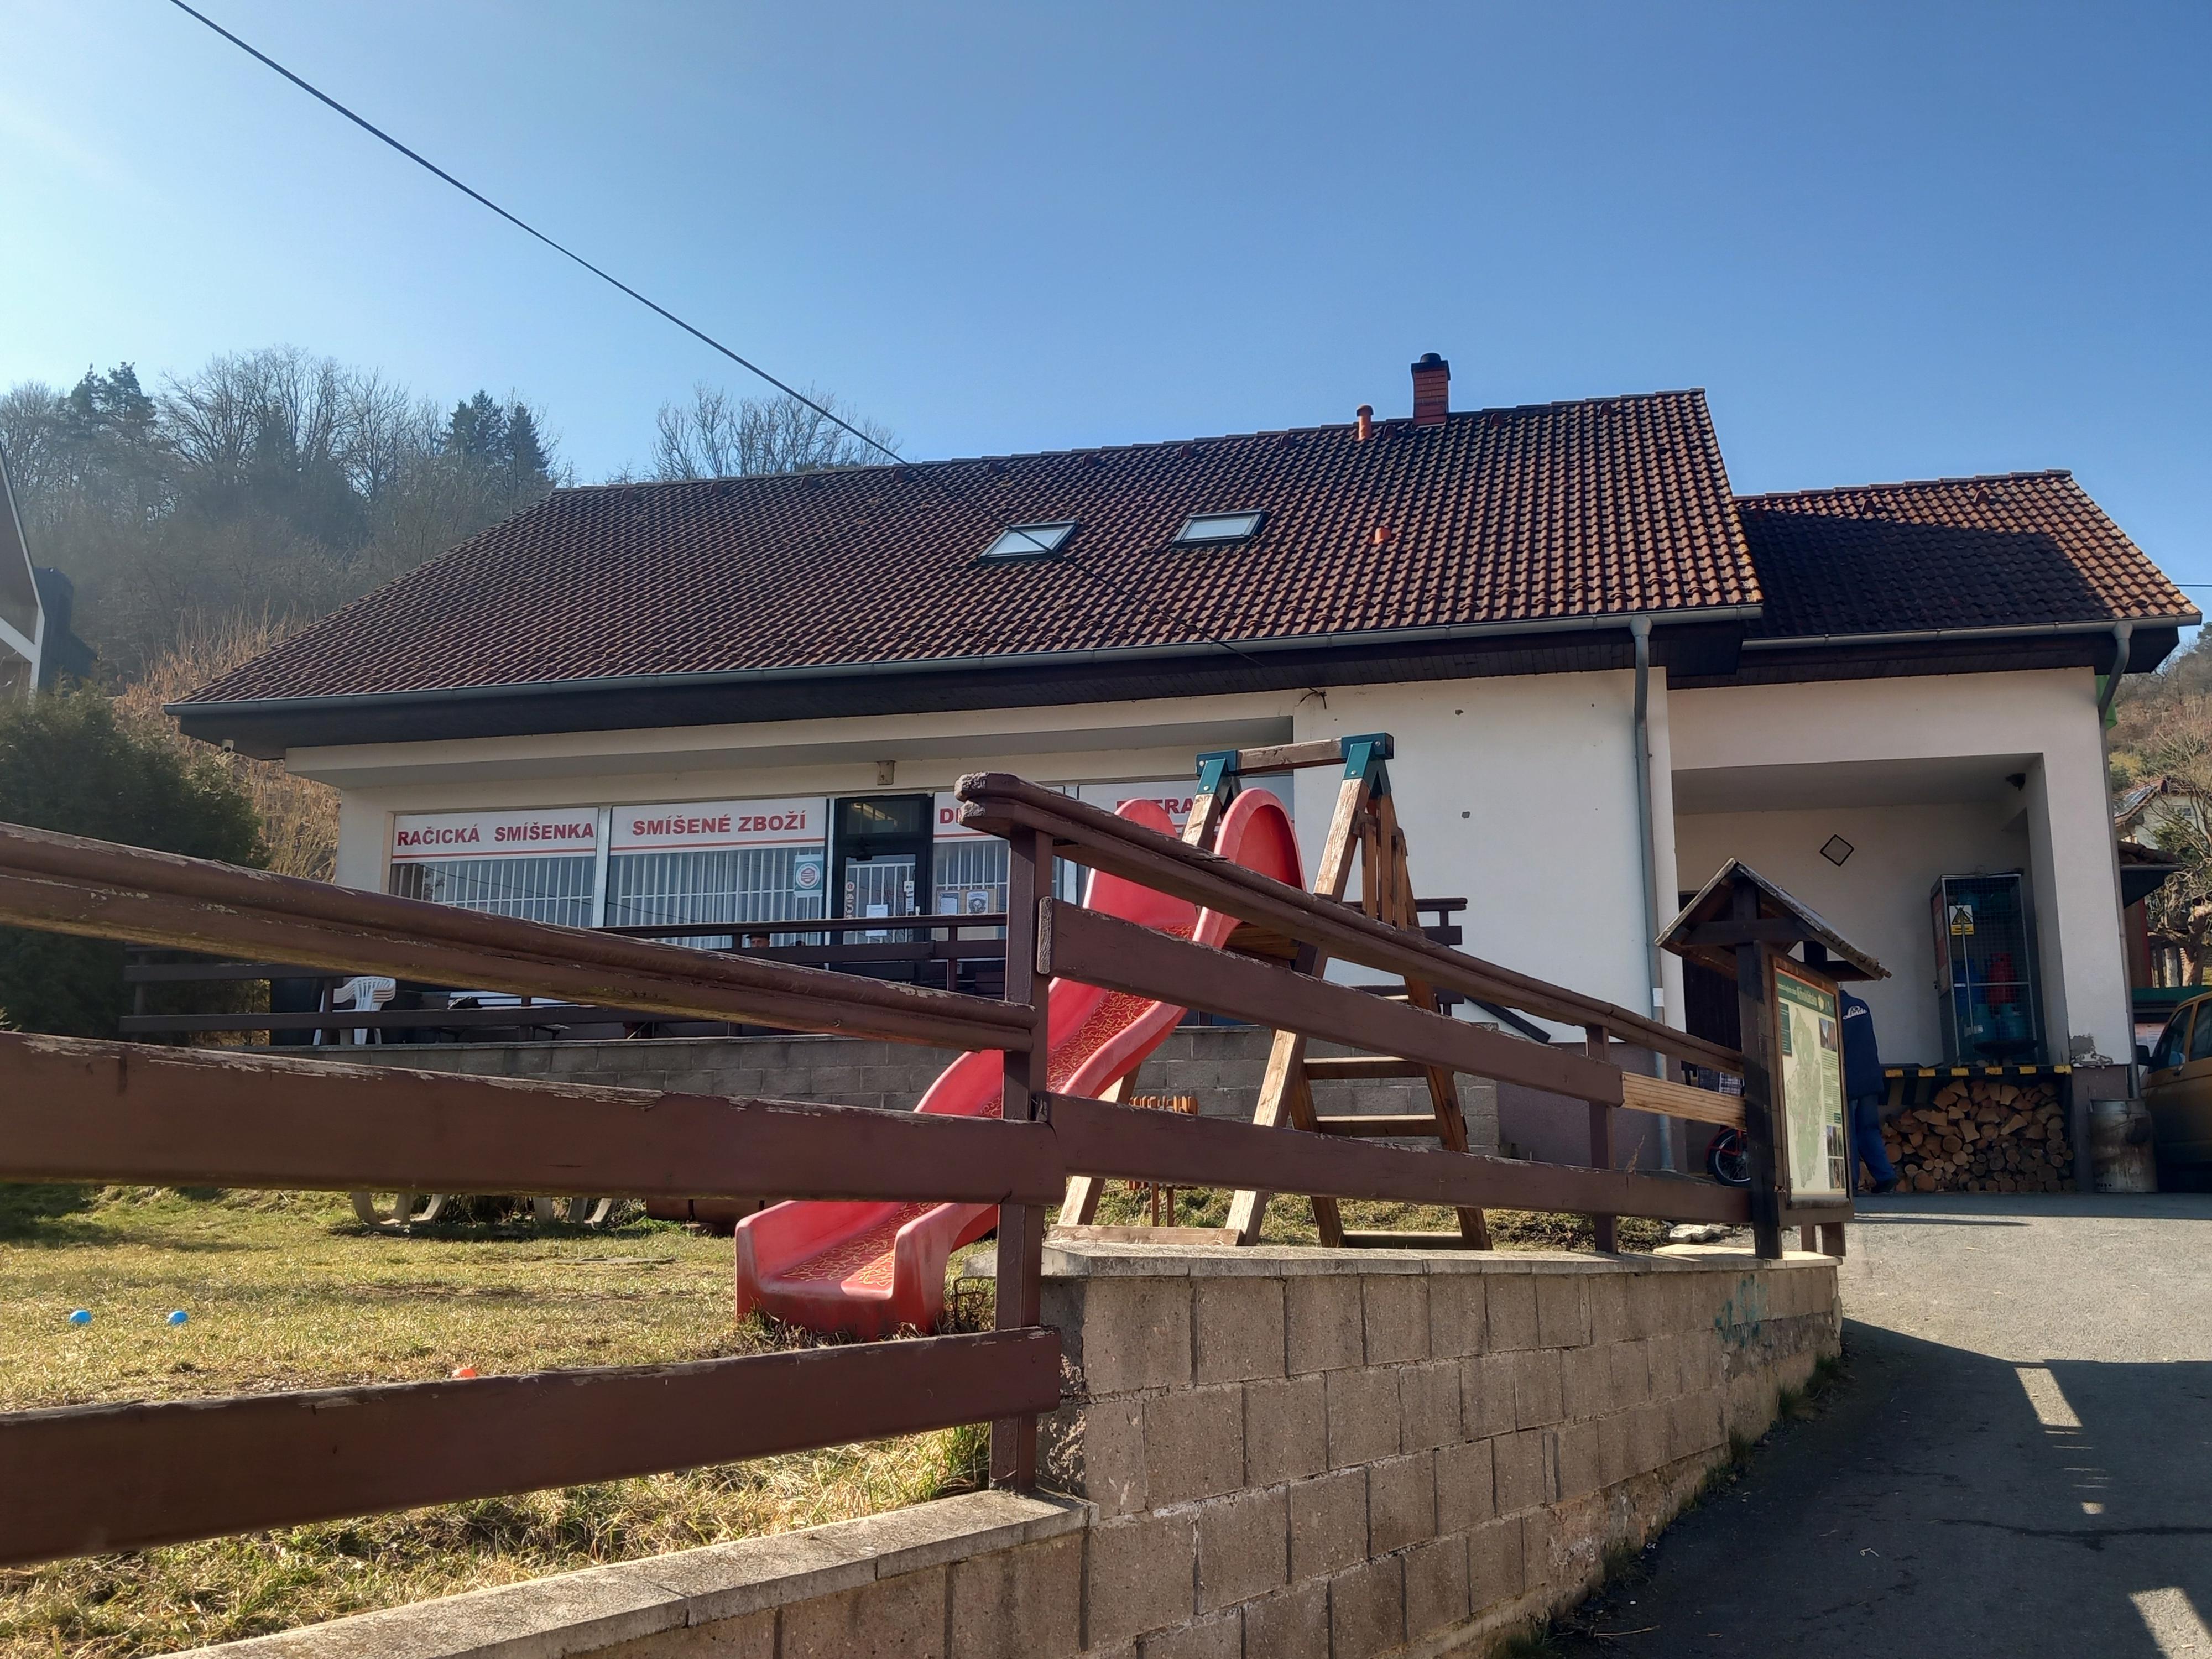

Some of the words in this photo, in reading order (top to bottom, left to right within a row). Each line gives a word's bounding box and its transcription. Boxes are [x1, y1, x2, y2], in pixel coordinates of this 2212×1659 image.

[397, 823, 480, 846] RAČICKÁ
[494, 821, 594, 842] SMÍŠENKA
[633, 813, 731, 836] SMÍŠENÉ
[738, 810, 807, 832] ZBOŽÍ
[1843, 1005, 1867, 1020] Linde
